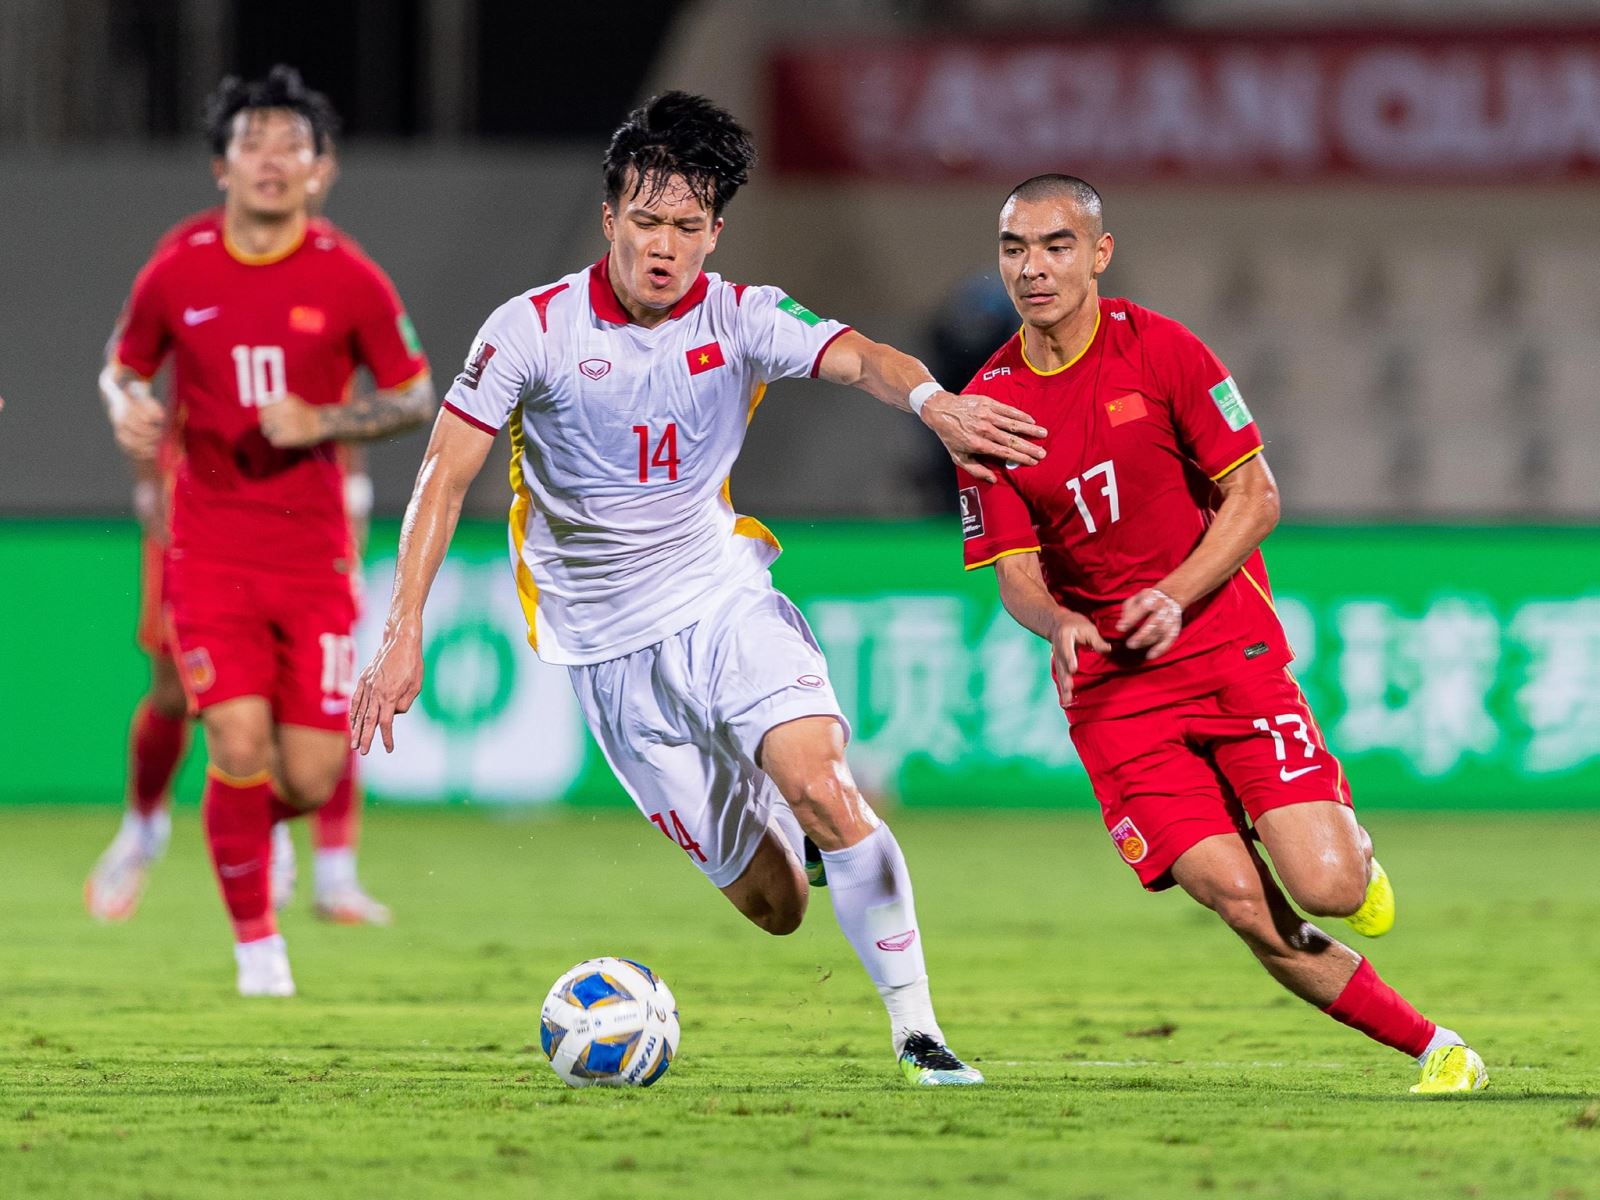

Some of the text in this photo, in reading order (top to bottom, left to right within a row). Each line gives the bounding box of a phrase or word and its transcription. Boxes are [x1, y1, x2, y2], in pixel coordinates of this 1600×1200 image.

[231, 345, 287, 408] 10
[983, 366, 1011, 381] CFA
[632, 422, 681, 483] 14
[1065, 459, 1120, 534] 17
[1252, 713, 1315, 761] 17
[650, 810, 708, 864] 14
